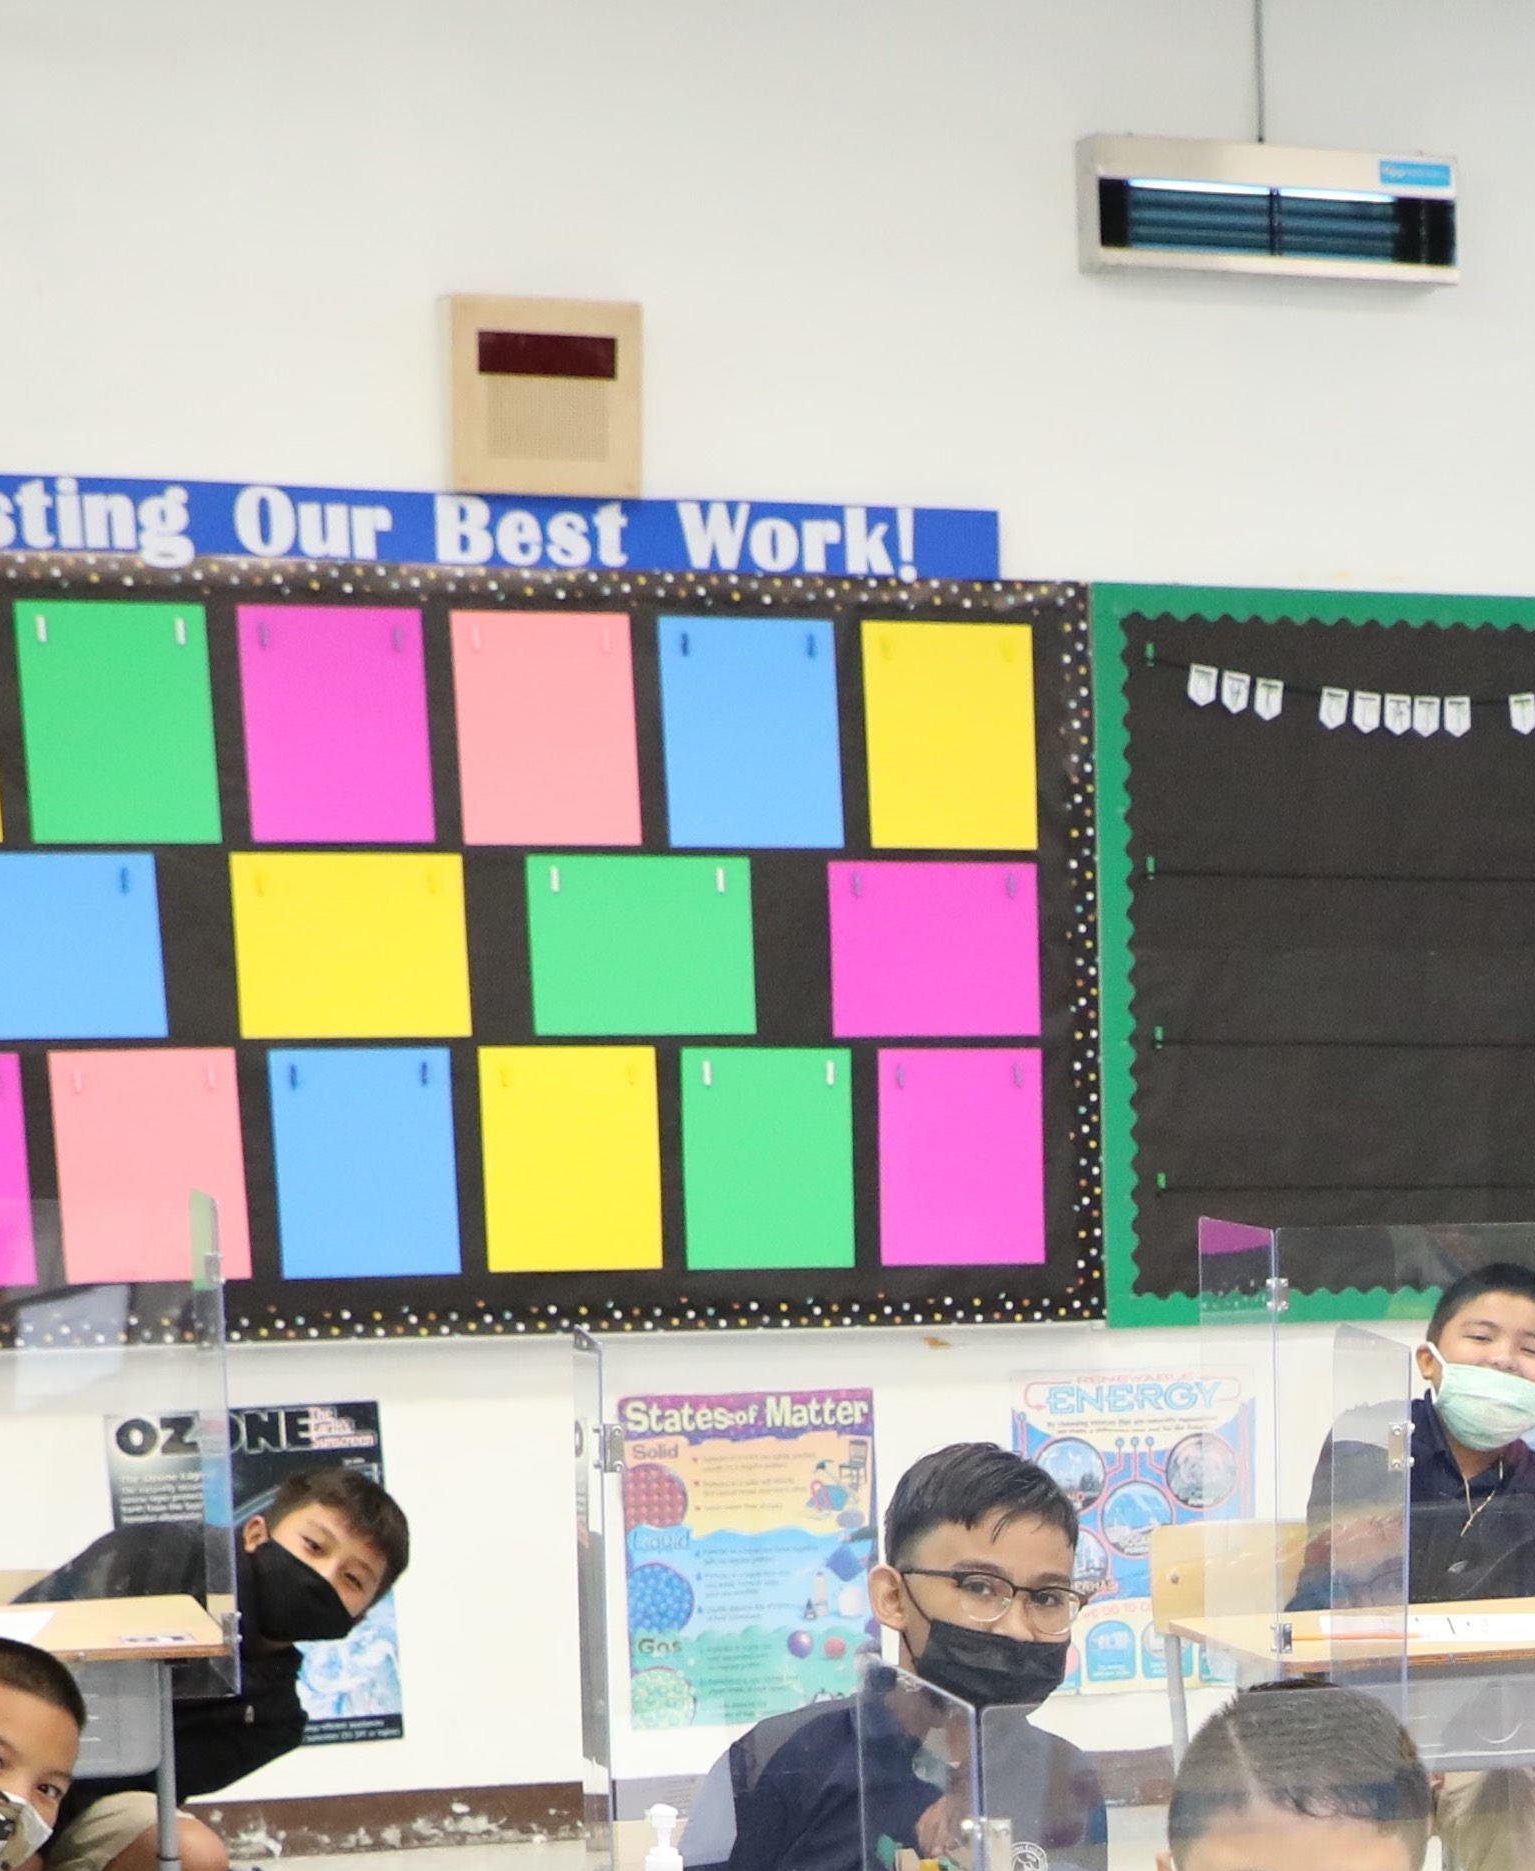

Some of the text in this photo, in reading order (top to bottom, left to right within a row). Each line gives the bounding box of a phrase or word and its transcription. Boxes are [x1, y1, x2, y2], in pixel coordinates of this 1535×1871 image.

[233, 484, 391, 560] Our
[434, 494, 629, 566] Best
[677, 501, 916, 583] Work!
[1049, 1380, 1222, 1414] ENERGY
[626, 1396, 868, 1433] States of Matter
[312, 1433, 377, 1448] Sunscreen
[632, 1442, 680, 1461] Solid
[632, 1530, 690, 1554] Liquid
[638, 1637, 683, 1656] Gas
